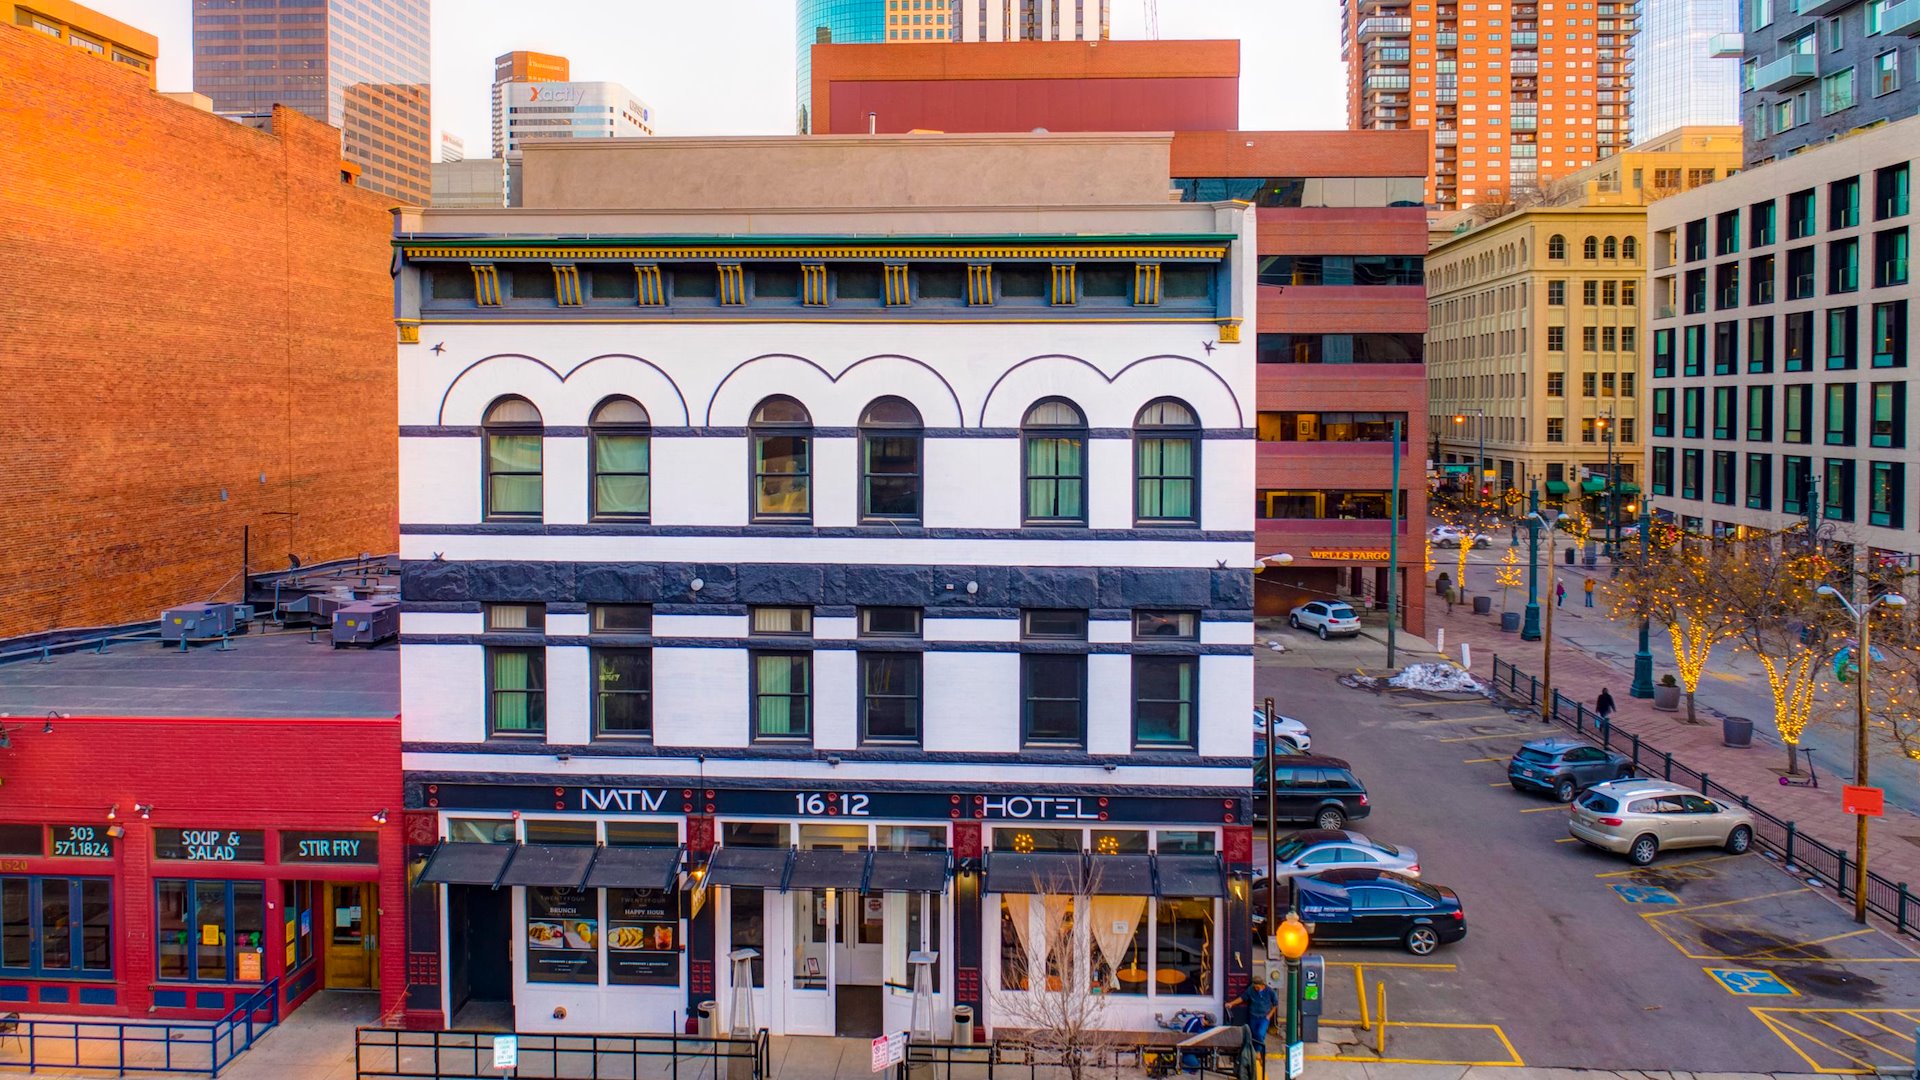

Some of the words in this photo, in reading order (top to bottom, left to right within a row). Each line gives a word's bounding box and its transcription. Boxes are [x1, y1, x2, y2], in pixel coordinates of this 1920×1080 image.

[530, 86, 585, 105] Xactly
[1311, 552, 1350, 560] WELLS
[1352, 552, 1390, 561] FARGO
[582, 789, 667, 811] NATIV
[984, 796, 1099, 819] HOTEL
[69, 826, 95, 841] 303
[182, 830, 220, 846] SOUP
[227, 832, 241, 846] &
[55, 840, 110, 857] 571.1824
[188, 845, 236, 861] SALAD
[299, 840, 331, 857] STIR
[333, 840, 360, 857] FRY
